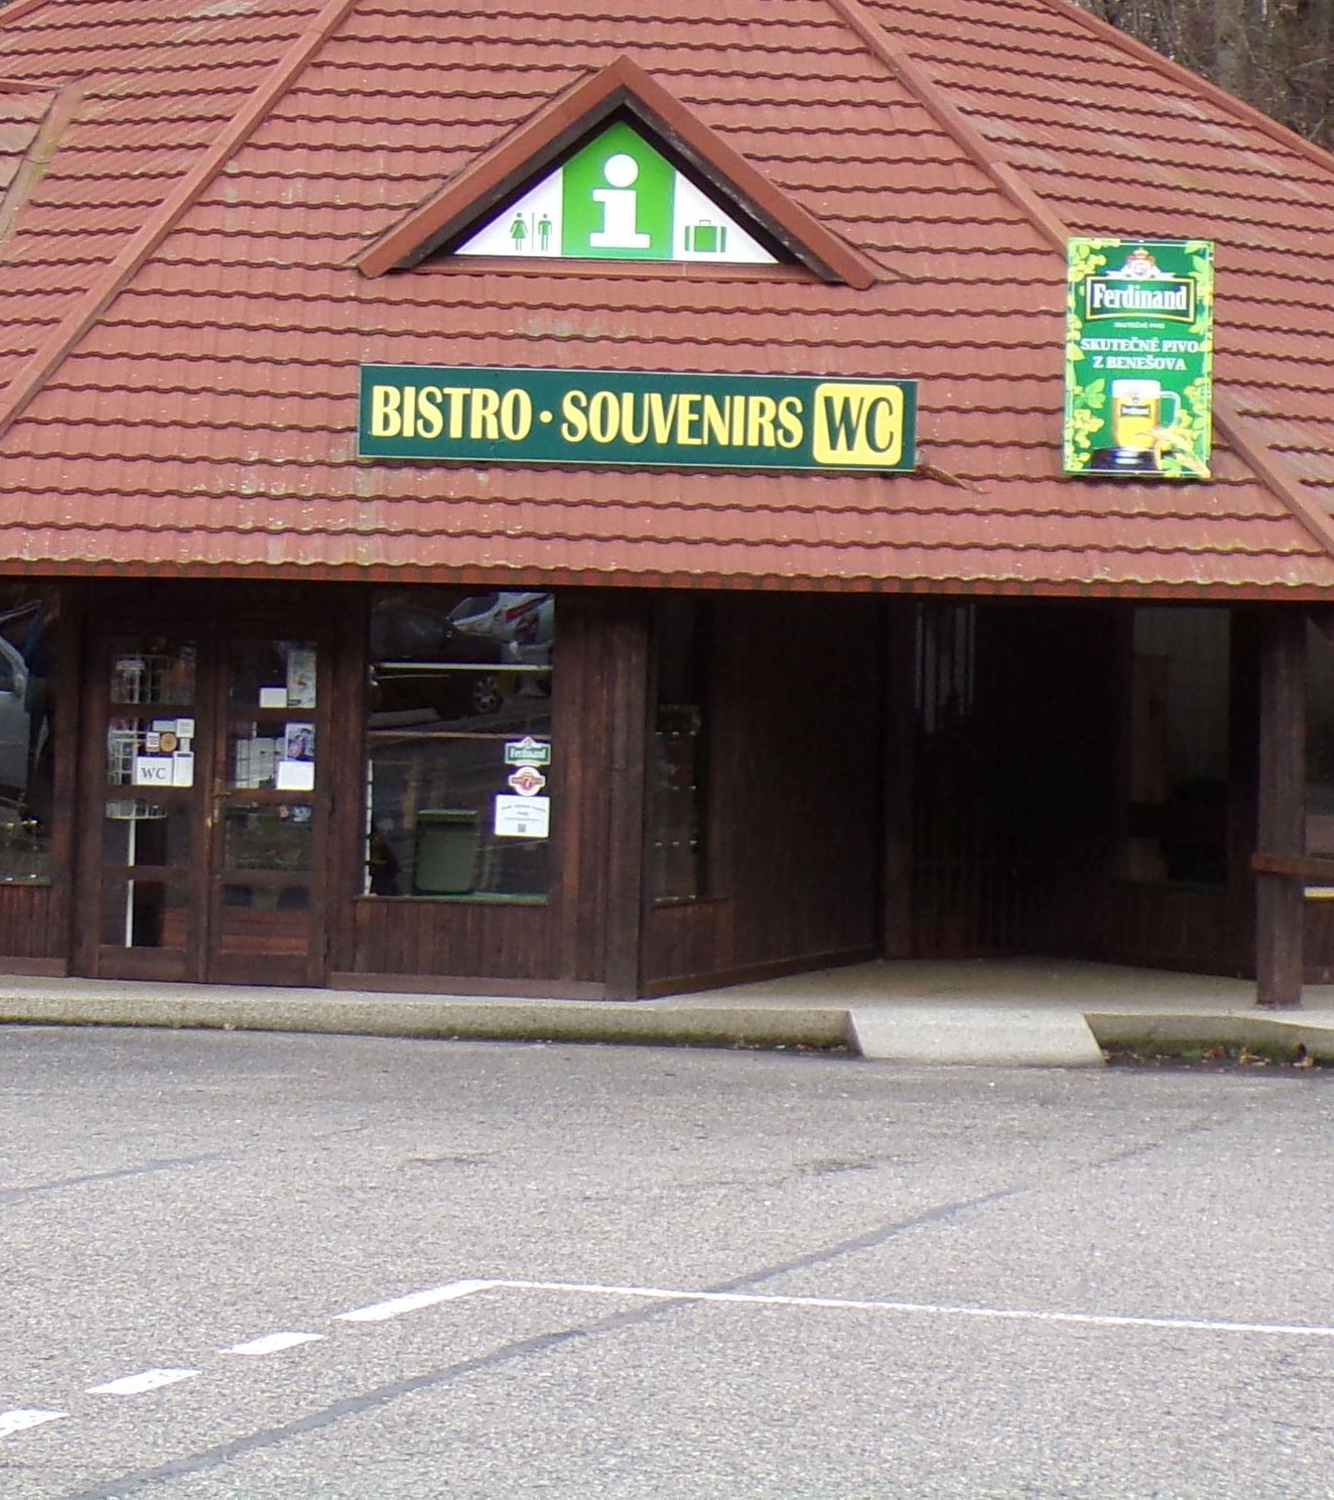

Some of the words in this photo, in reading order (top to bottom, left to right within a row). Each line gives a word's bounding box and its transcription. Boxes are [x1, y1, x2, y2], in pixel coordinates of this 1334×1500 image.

[1092, 282, 1188, 310] Ferdinand
[1080, 336, 1160, 352] SKUTEČNÉ
[1161, 340, 1199, 353] PIVO
[1092, 355, 1104, 369] Z
[1105, 354, 1187, 371] BENEŠOVA
[370, 384, 532, 441] BISTRO
[561, 389, 805, 449] SOUVENIRS
[823, 395, 896, 453] WC
[140, 767, 168, 780] WC
